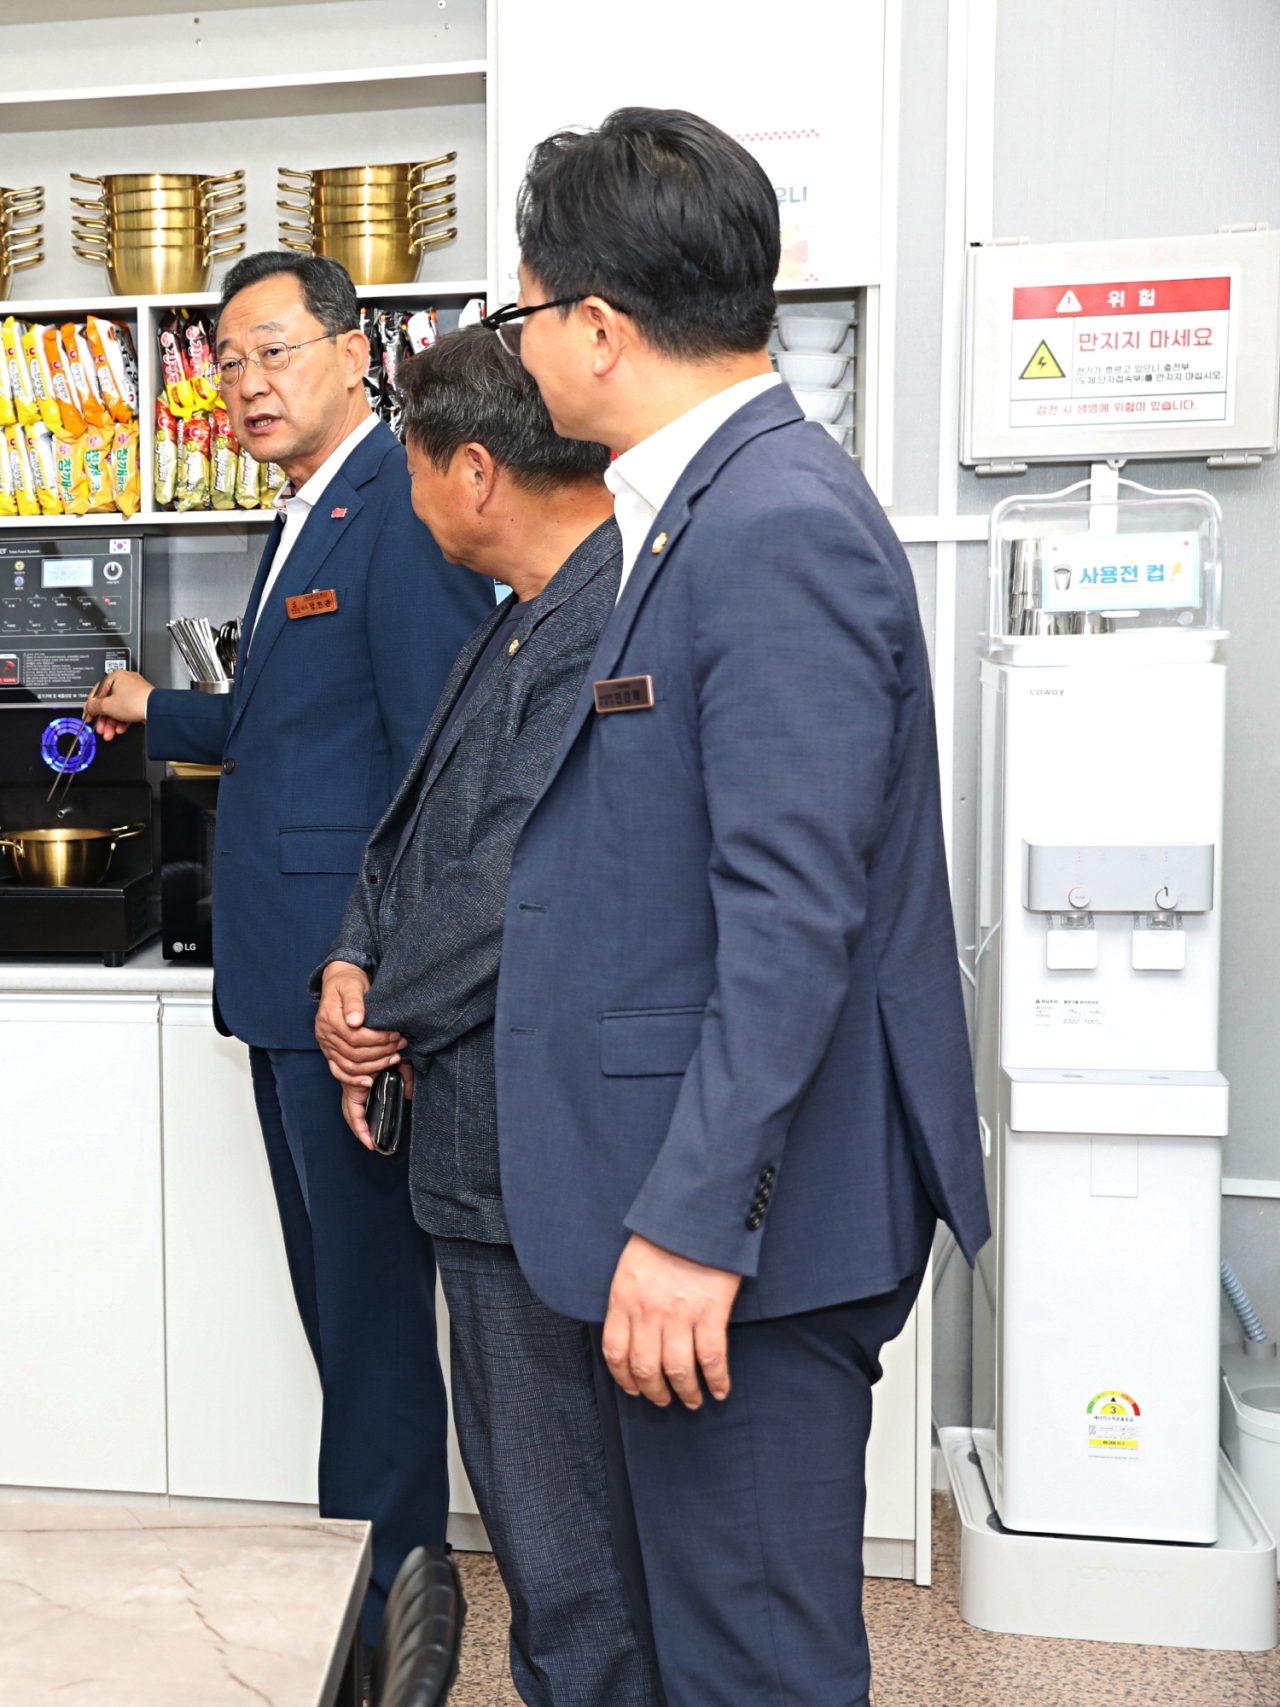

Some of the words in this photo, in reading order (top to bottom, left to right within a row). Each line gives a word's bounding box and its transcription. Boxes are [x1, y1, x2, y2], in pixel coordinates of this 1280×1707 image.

[1079, 331, 1141, 351] 만지지
[1150, 328, 1213, 348] 마세요
[1079, 565, 1139, 584] 사용전
[1147, 564, 1164, 582] 컵
[184, 943, 197, 951] LG
[1110, 1406, 1117, 1415] 3
